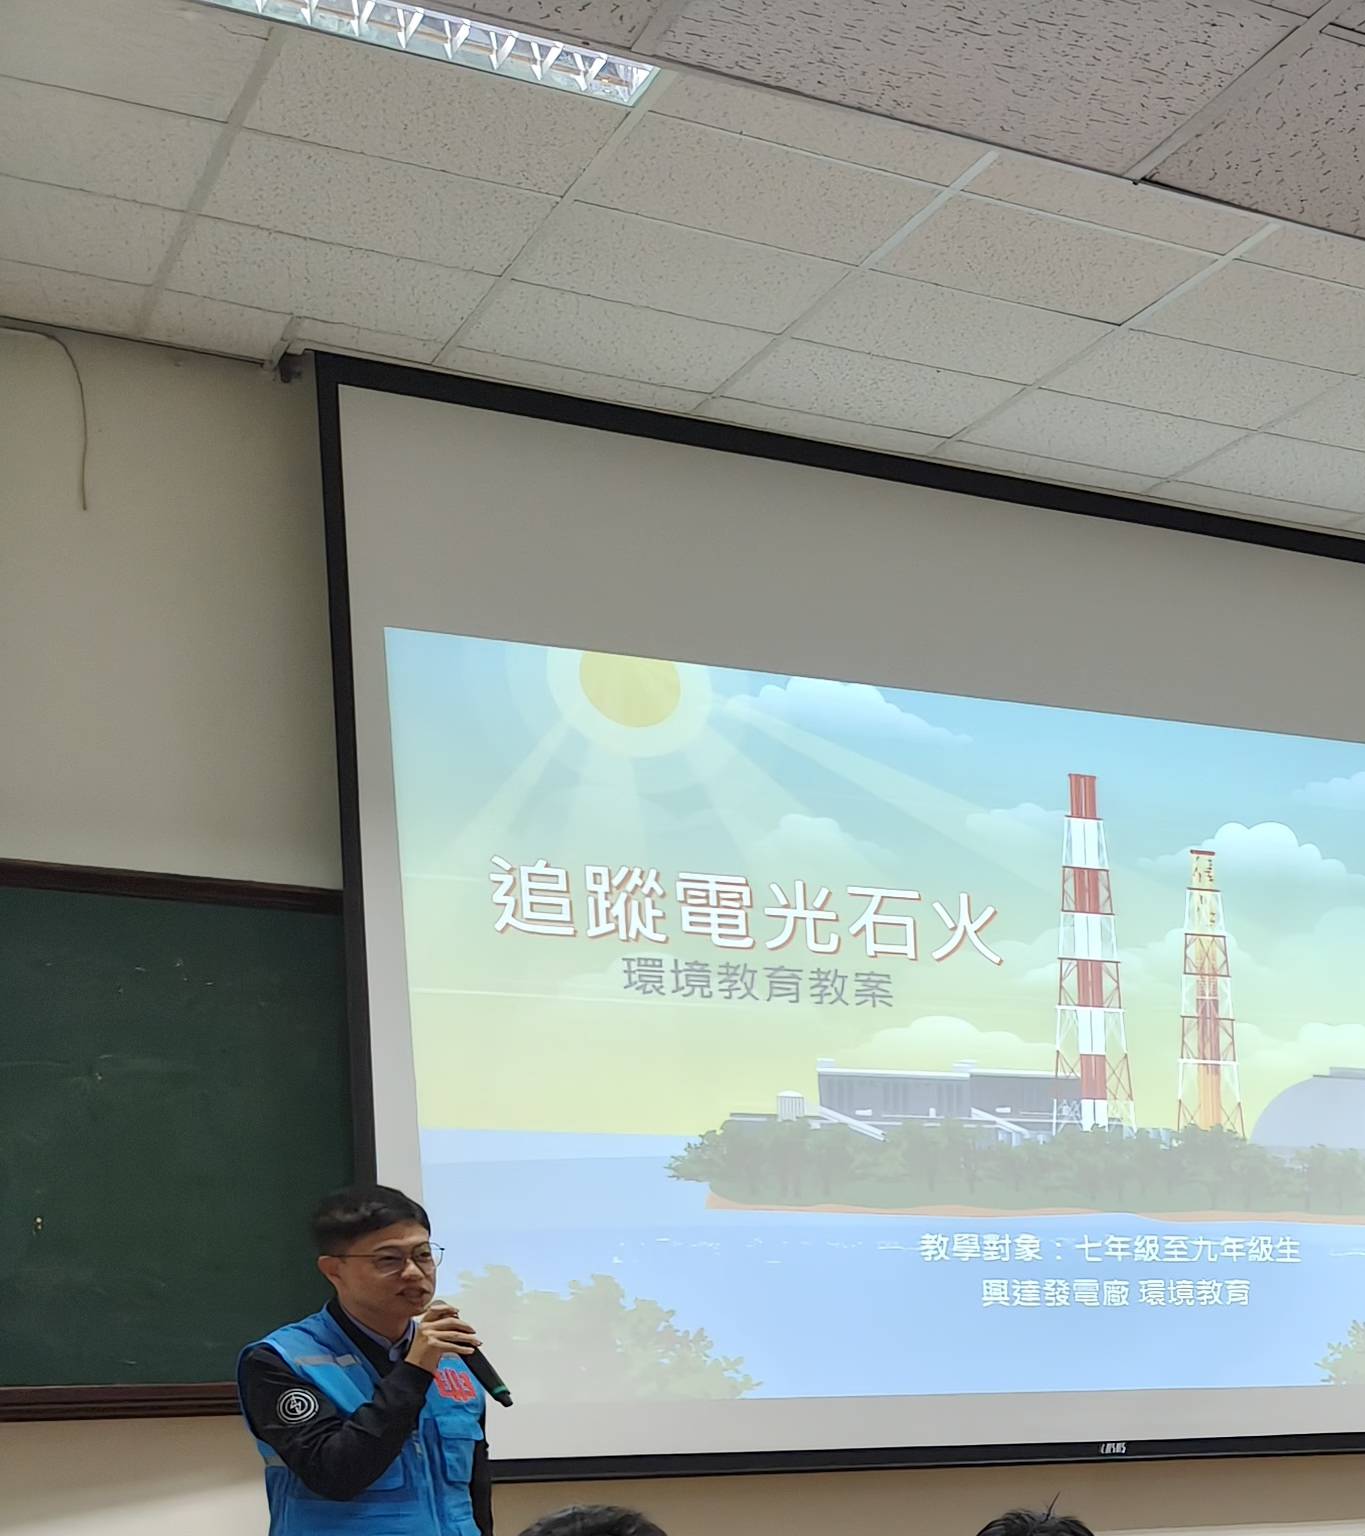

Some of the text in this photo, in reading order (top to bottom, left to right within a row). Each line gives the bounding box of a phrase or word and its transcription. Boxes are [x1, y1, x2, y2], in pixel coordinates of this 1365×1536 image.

[489, 855, 1004, 966] 追蹤電光石火
[621, 956, 895, 1009] 環境教育教案
[981, 1279, 1251, 1308] 興達發電廠 環境教育
